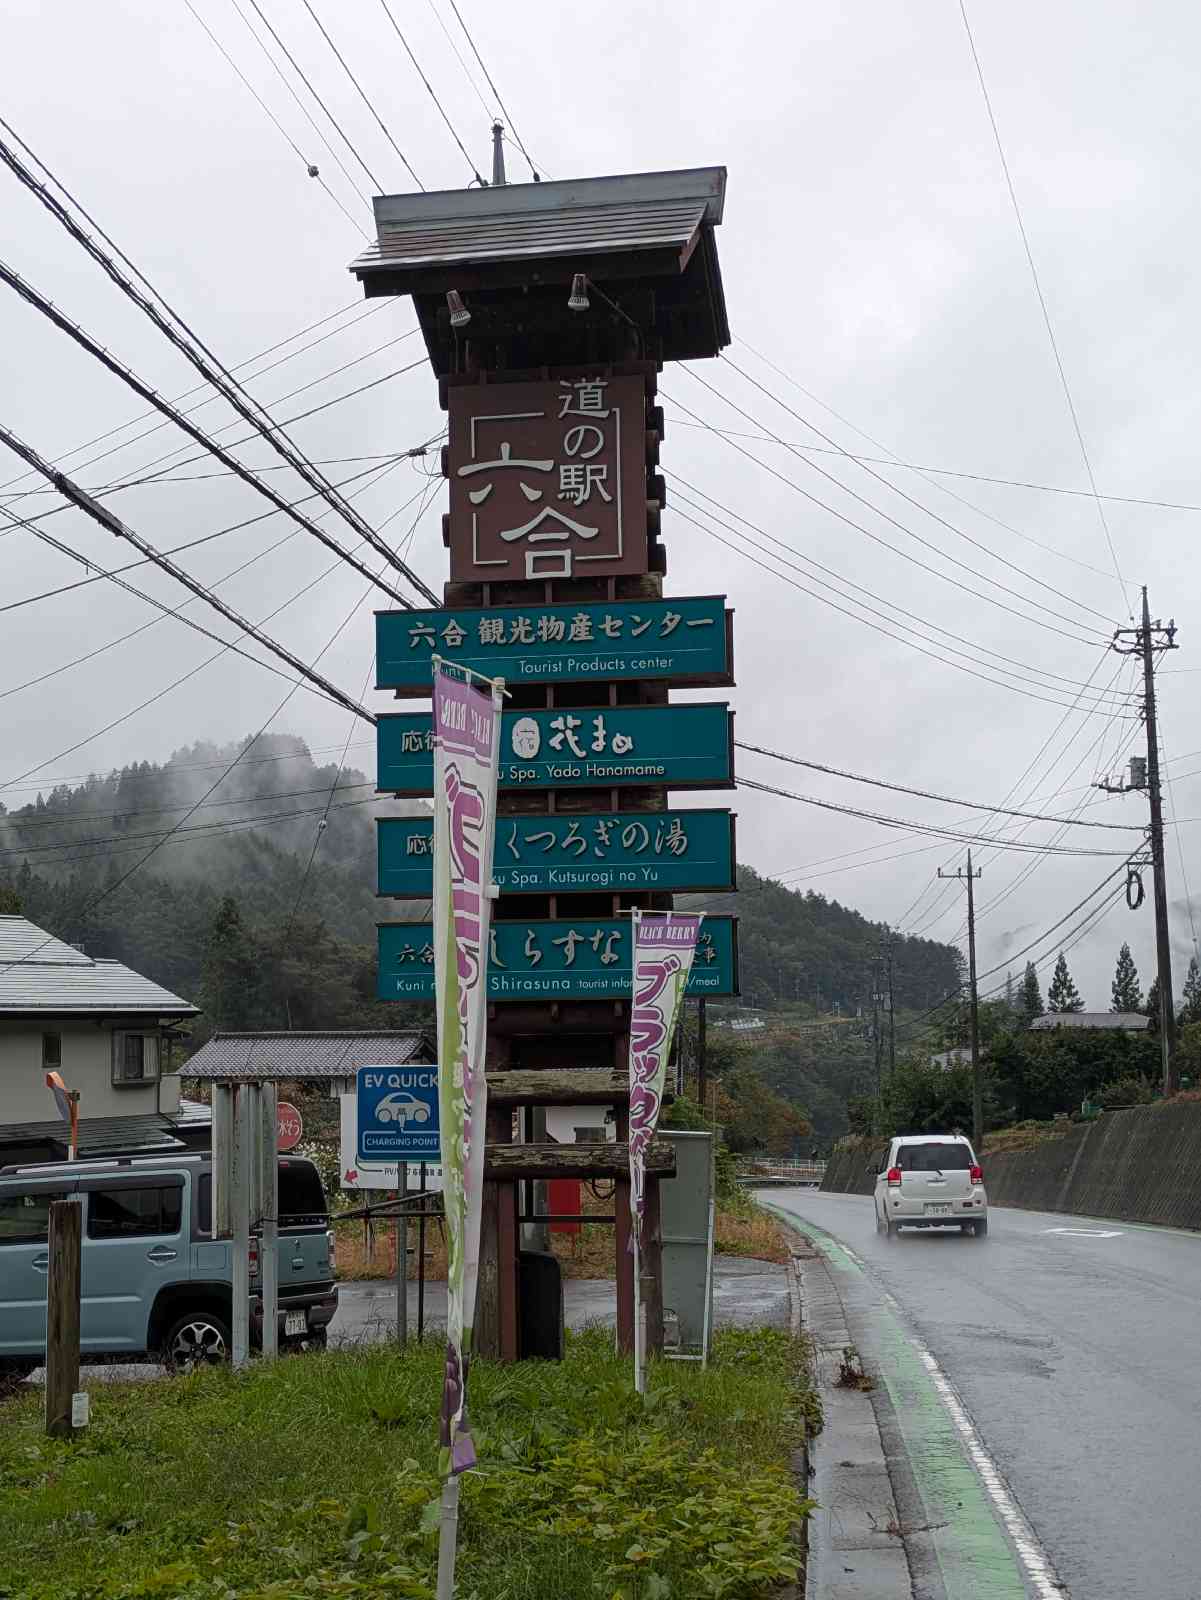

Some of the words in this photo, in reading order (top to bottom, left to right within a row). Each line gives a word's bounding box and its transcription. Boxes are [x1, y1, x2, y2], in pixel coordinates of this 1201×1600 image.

[558, 377, 613, 506] 道の駅
[457, 442, 599, 580] 六合
[407, 618, 468, 648] 六合
[477, 611, 714, 645] 観光物産センター
[519, 660, 562, 674] Tourist
[567, 657, 625, 673] Products
[631, 657, 673, 670] center
[510, 765, 541, 784] Spa.
[546, 763, 581, 778] Yado
[586, 763, 665, 777] Hanamame
[506, 818, 688, 859] くつろぎの湯
[511, 870, 542, 888] Spa.
[548, 868, 614, 886] Kutsurogi
[619, 871, 637, 882] no
[641, 867, 659, 882] Yu
[639, 926, 664, 940] BLACK
[666, 925, 696, 940] BERRY
[489, 928, 622, 968] しらすな
[396, 979, 425, 992] Kuni
[490, 976, 571, 991] Shirasuna
[578, 979, 608, 990] tourist
[364, 1073, 384, 1089] EV
[387, 1073, 439, 1089] QUICK
[366, 1137, 411, 1147] CHARGING
[413, 1136, 438, 1147] POINT
